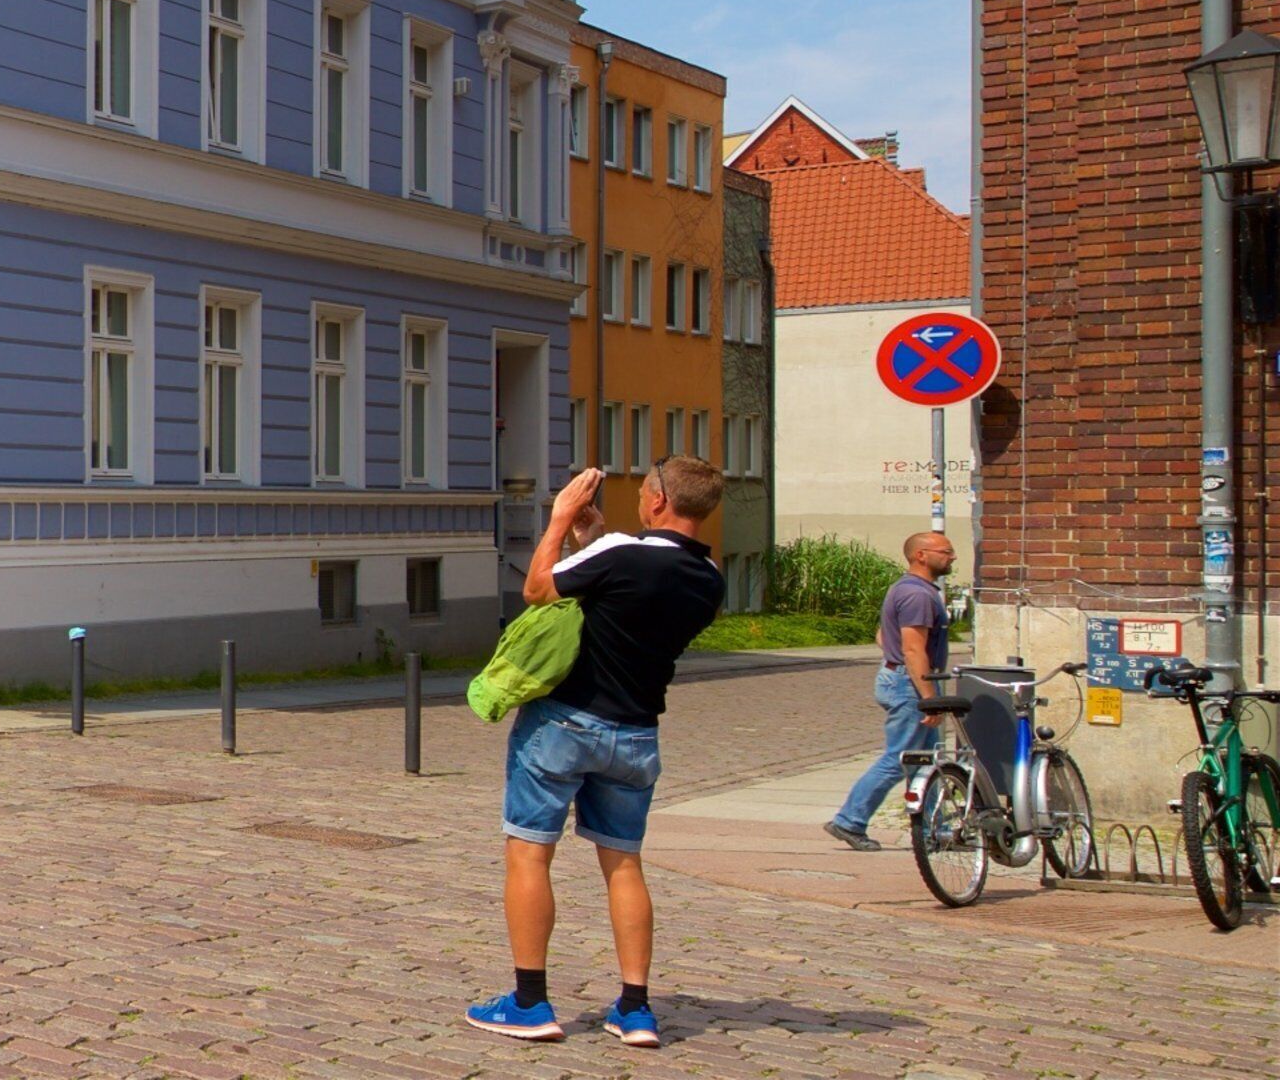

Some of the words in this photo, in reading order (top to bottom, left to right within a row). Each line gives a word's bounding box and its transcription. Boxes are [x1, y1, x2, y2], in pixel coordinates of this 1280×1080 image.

[882, 460, 970, 472] re:MDE
[882, 485, 909, 494] HIER
[914, 485, 929, 494] IM
[1087, 621, 1103, 631] HS
[1095, 657, 1104, 666] S
[1128, 659, 1137, 668] S
